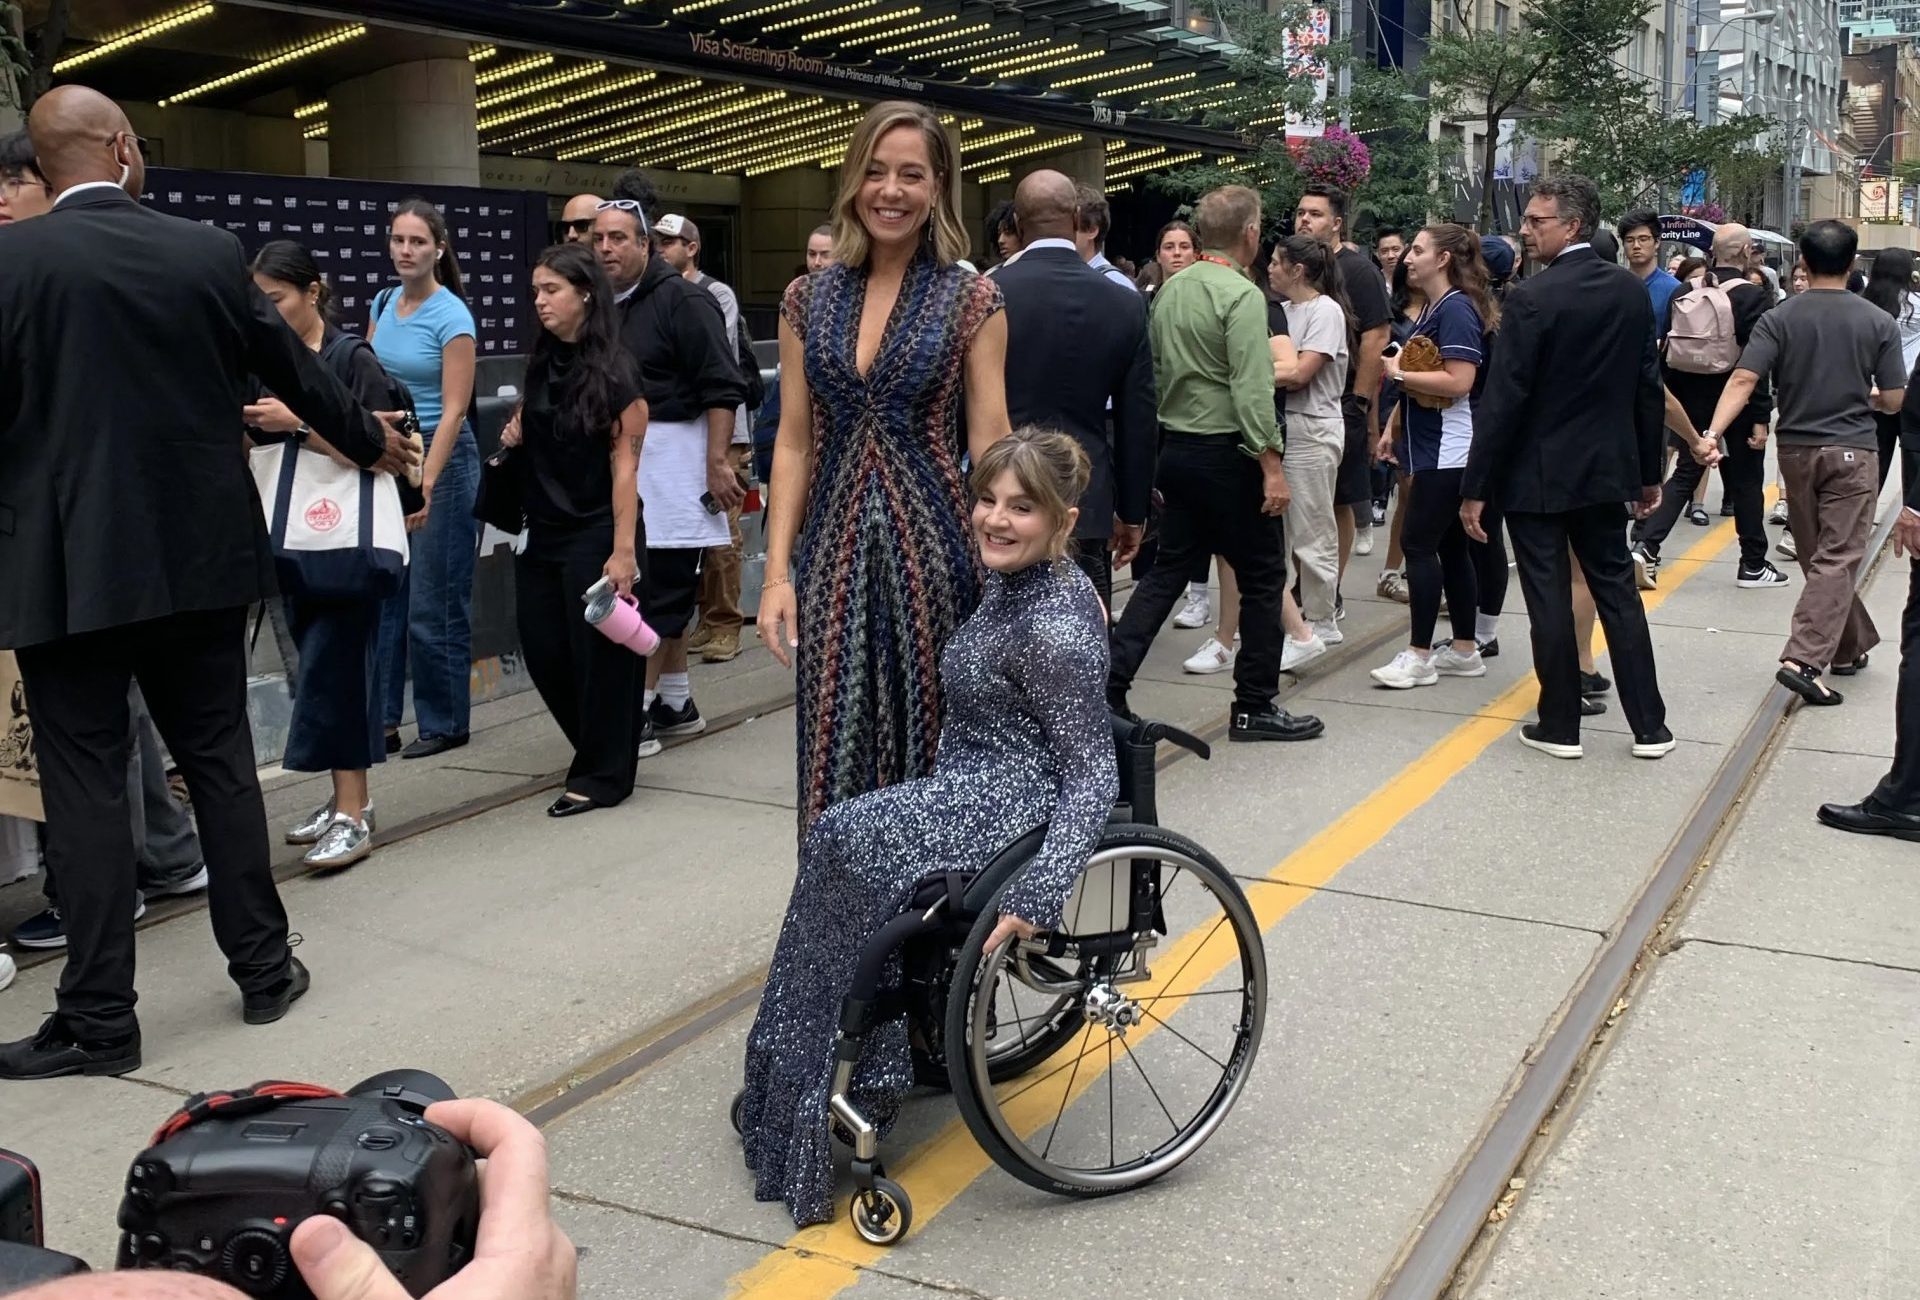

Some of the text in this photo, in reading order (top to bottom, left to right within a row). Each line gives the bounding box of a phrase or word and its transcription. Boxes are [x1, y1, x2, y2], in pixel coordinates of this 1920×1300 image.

[689, 32, 720, 56] Visa
[722, 37, 786, 72] Screening
[787, 50, 824, 75] Room
[824, 64, 834, 77] At
[834, 65, 846, 79] the
[846, 67, 874, 83] Princess
[881, 73, 901, 88] Wales
[901, 77, 925, 92] Theatre
[1091, 105, 1112, 125] VISA
[1667, 221, 1696, 229] Infinite
[1682, 230, 1700, 238] Line
[457, 252, 471, 260] VISA
[480, 275, 494, 283] VISA
[502, 297, 515, 305] VISA
